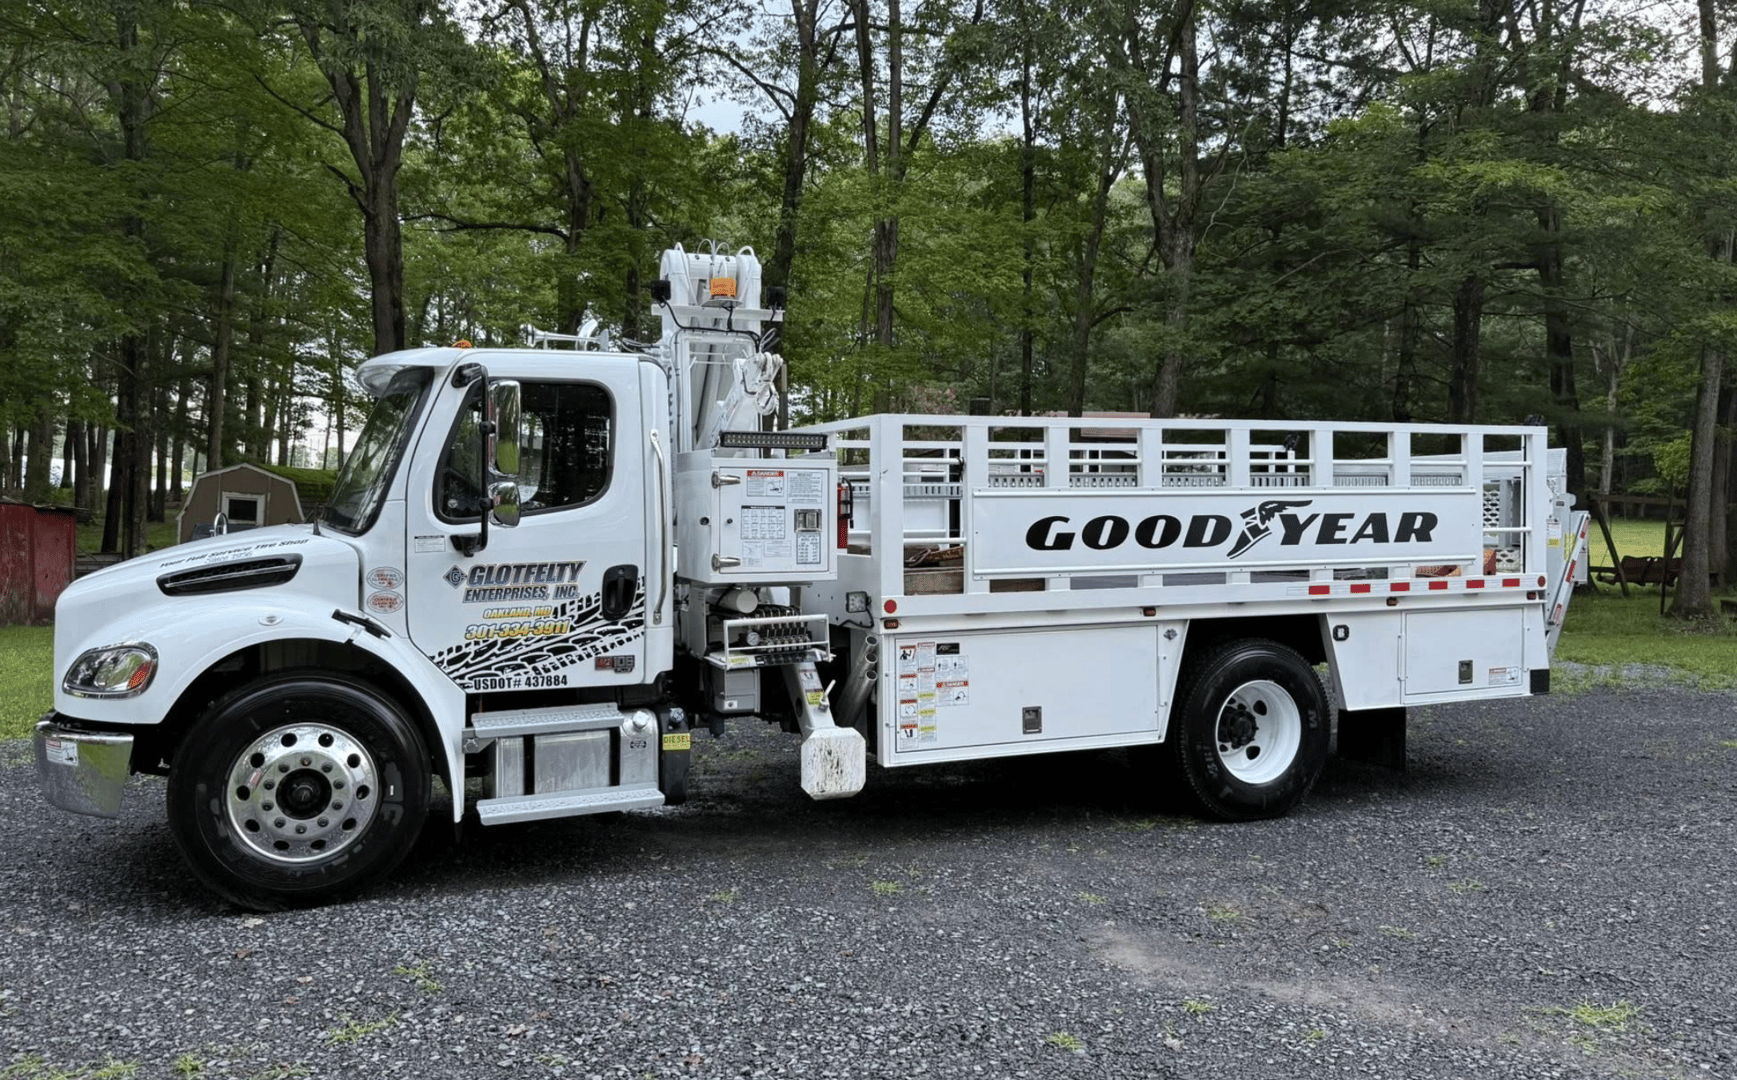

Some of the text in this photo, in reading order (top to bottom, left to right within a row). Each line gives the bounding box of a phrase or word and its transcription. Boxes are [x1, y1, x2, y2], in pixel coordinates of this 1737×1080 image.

[209, 547, 252, 558] Service
[279, 539, 309, 547] Shop
[467, 561, 586, 587] GLOTFELTY
[553, 584, 580, 600] INC.
[465, 620, 571, 640] 301-334-3911
[474, 675, 567, 690] USDOT# 437884
